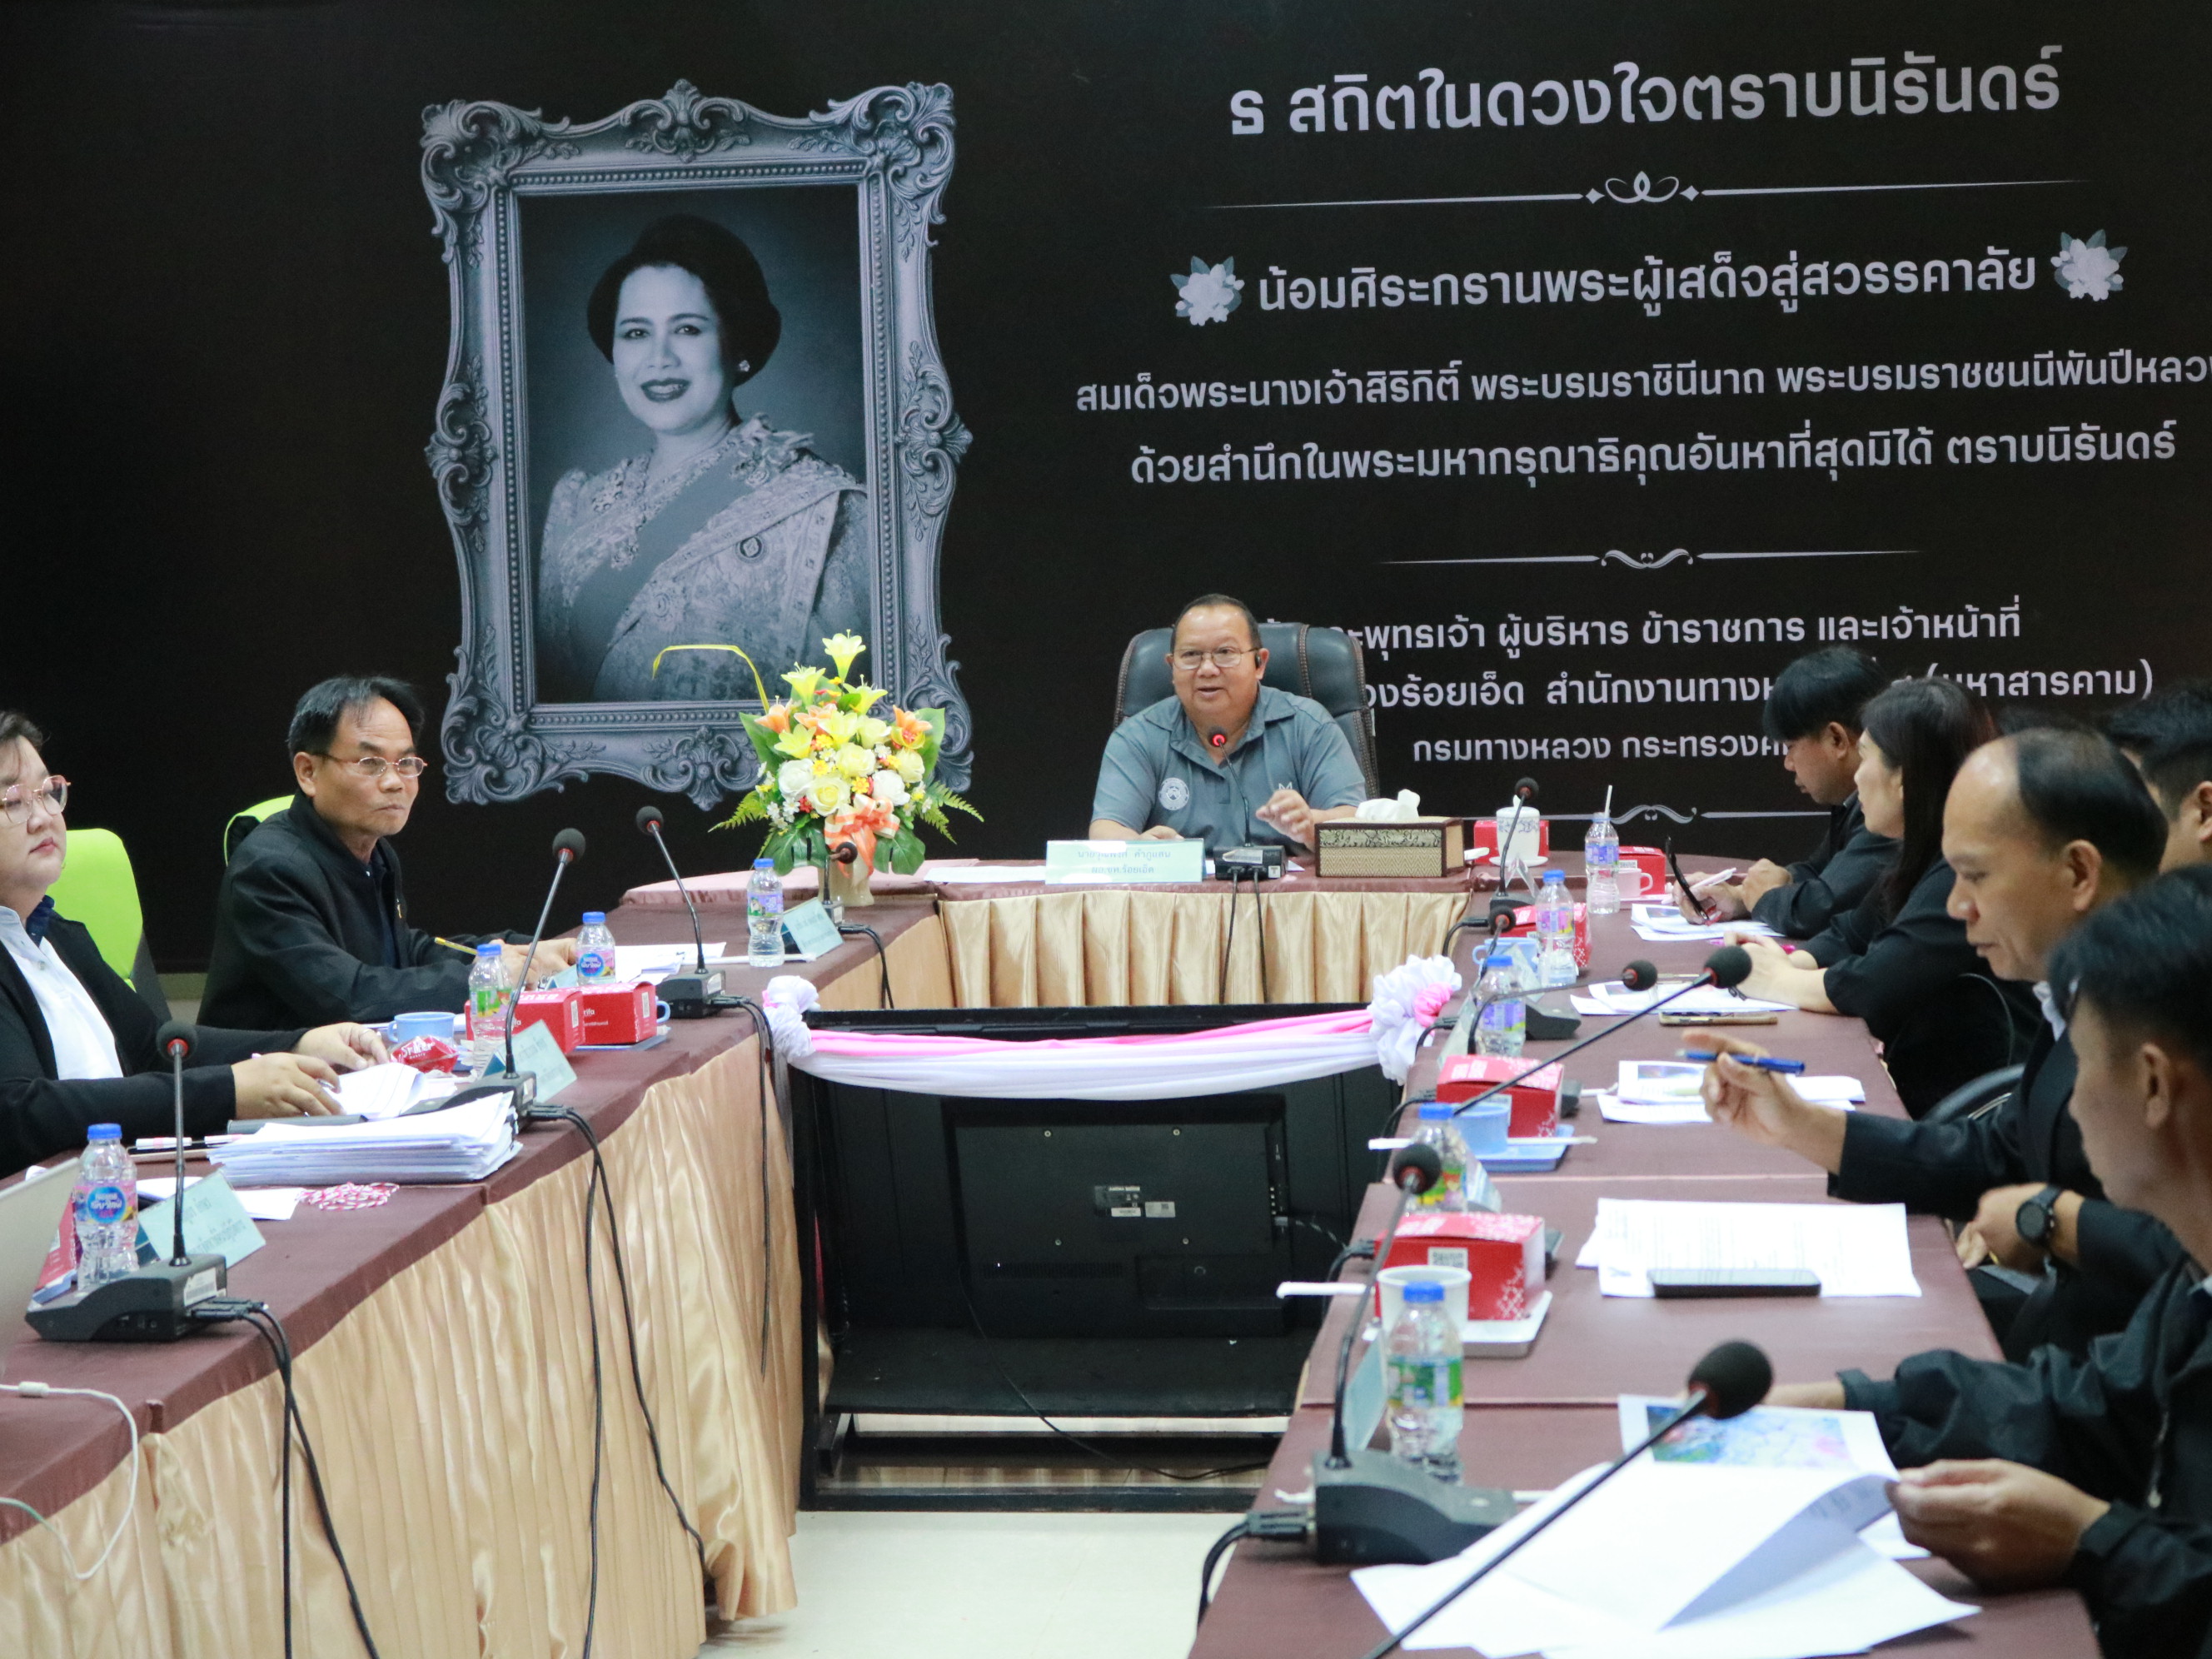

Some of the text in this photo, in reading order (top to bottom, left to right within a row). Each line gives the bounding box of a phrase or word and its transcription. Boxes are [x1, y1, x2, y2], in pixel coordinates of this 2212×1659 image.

[1230, 45, 2062, 135] ธ สถิตในดวงใจตราบนิรันดร์
[1259, 245, 2035, 317] น้อมศิระกรานพระผู้เสด็จสู่สวรรคาลัย
[1077, 348, 2212, 411] สมเด็จพระนางเจ้าสิริกิติ์ พระบรมราชินีนาถ พระบรมราชชนนีพันปีหลว
[1946, 419, 2177, 464] ตราบนิรันดร์
[1498, 613, 1629, 659] ผู้บริหาร
[1642, 610, 1806, 645] ข้าราชการ
[1818, 595, 2020, 641] และเจ้าหน้าที่
[1413, 735, 1789, 761] กรมทางหลวง กระทรวงค
